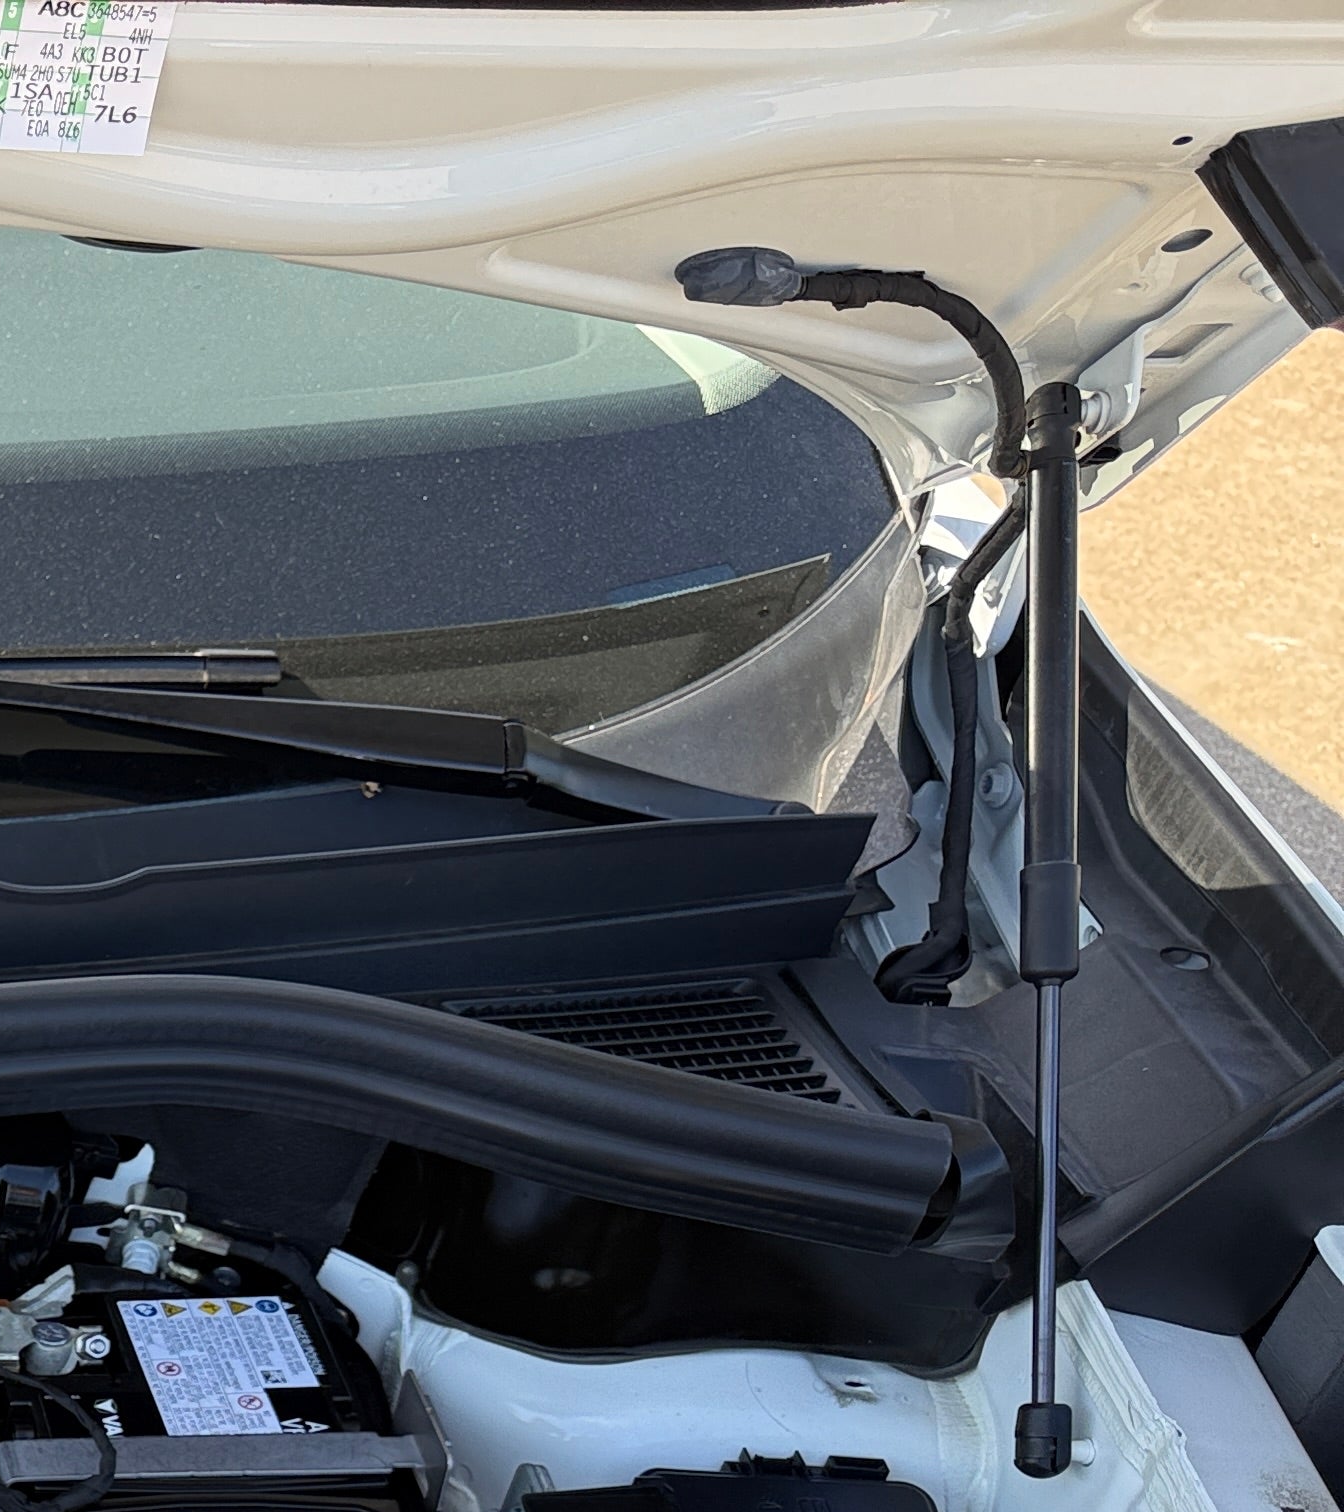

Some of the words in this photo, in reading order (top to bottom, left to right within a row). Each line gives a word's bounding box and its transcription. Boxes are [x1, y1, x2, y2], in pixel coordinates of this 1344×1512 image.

[8, 2, 18, 18] 5
[38, 0, 86, 18] A8C
[87, 65, 141, 83] TUB1
[95, 105, 137, 123] 7L6
